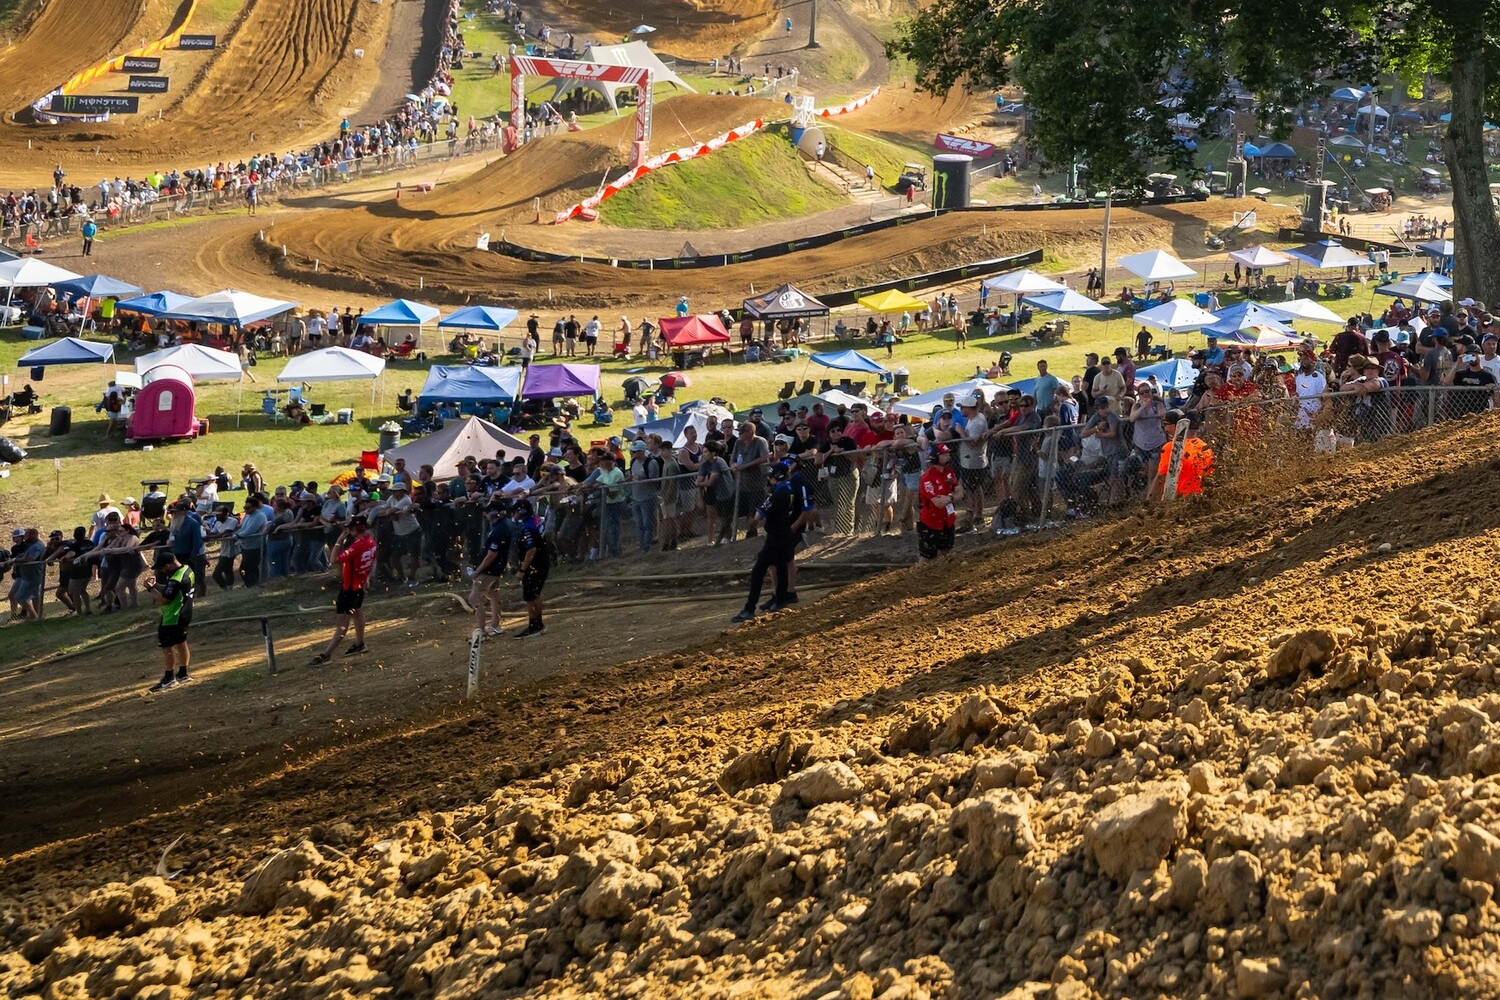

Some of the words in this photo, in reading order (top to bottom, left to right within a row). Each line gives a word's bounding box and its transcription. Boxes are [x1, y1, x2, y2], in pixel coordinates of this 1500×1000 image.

[547, 60, 612, 76] FLY
[79, 97, 129, 106] MONSTER
[938, 134, 993, 153] FLY
